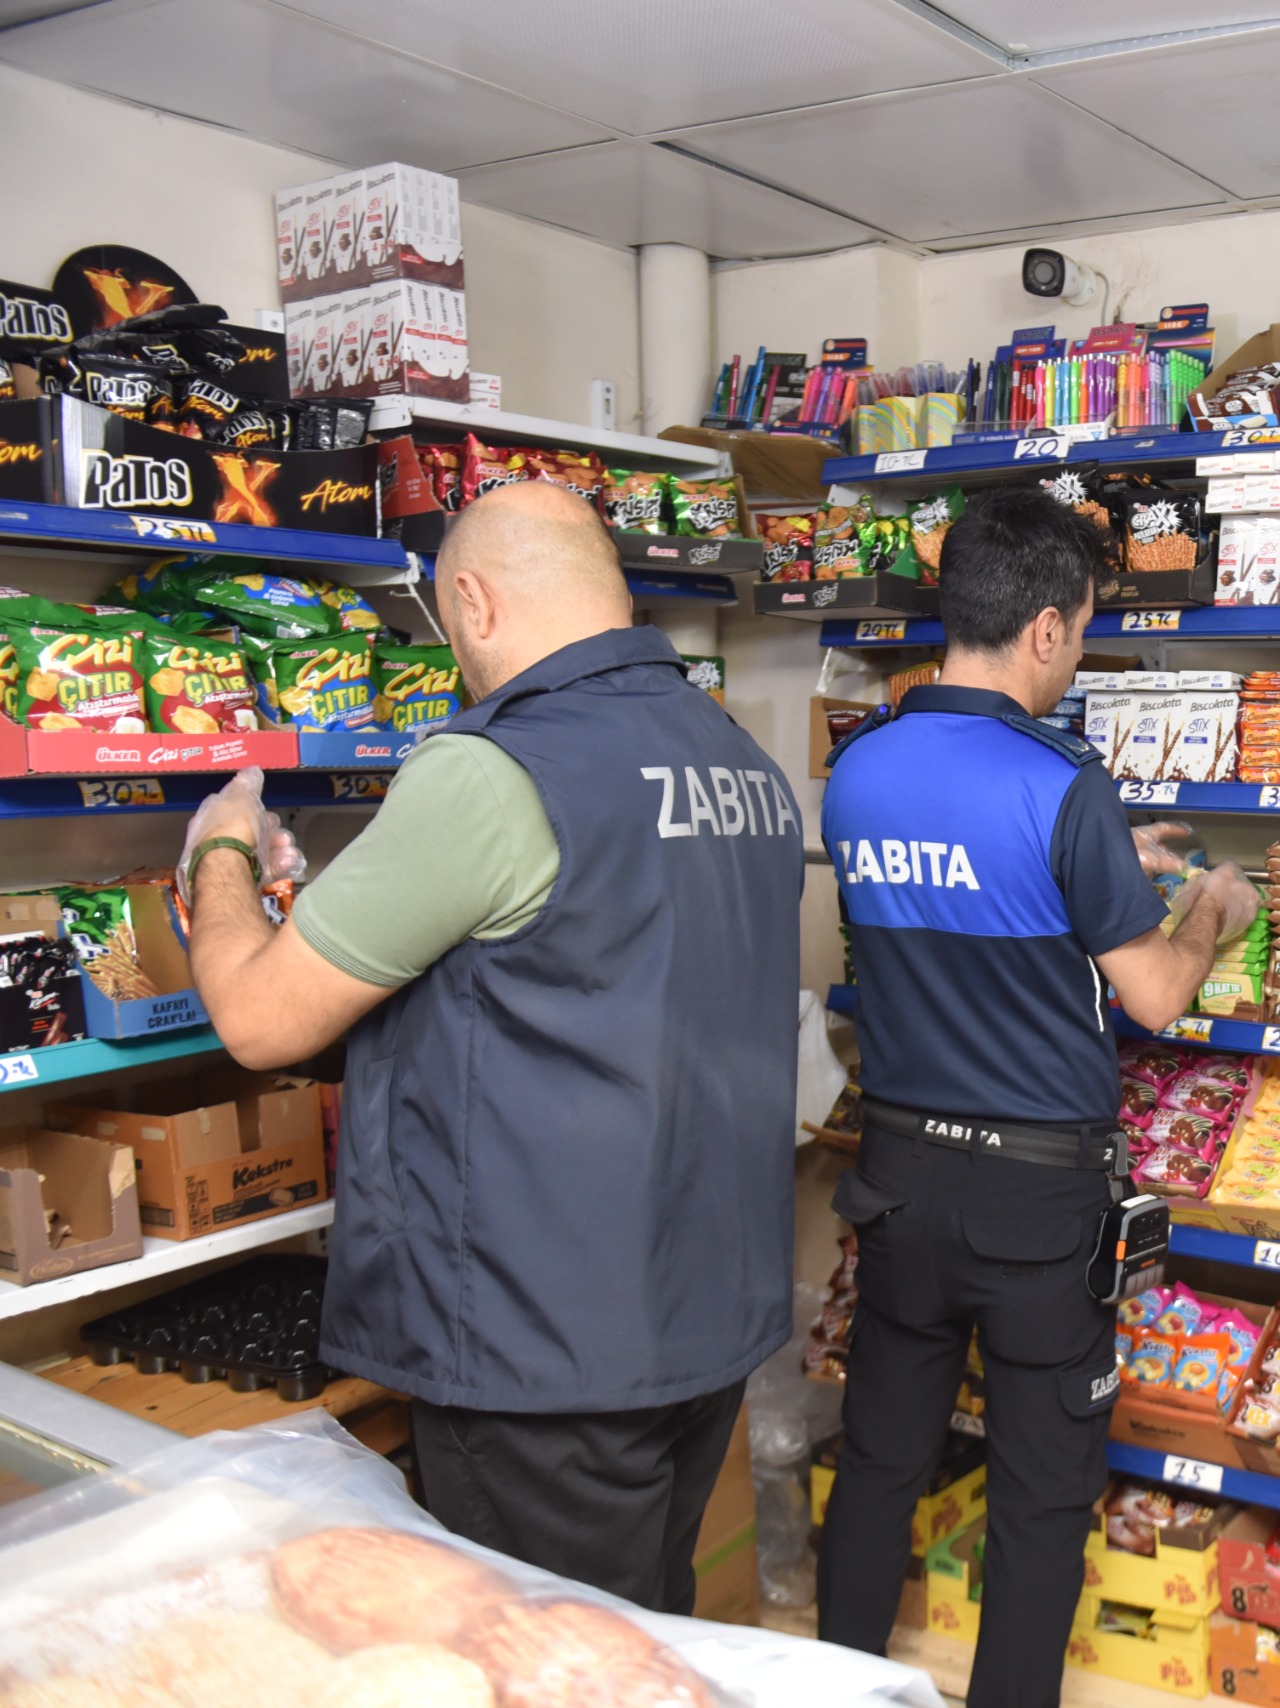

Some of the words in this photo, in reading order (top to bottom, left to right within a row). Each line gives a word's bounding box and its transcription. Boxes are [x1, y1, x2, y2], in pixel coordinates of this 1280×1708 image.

[1022, 439, 1059, 458] 20
[301, 478, 373, 514] Atom
[296, 647, 372, 692] Çizi
[383, 662, 461, 701] Çizi
[57, 671, 134, 713] ÇITIR
[1089, 697, 1131, 713] Biscolata
[1139, 697, 1182, 713] Biscolata
[312, 685, 370, 726] ÇITIR
[393, 699, 450, 733] ÇITIR
[1189, 697, 1234, 714] Biscolata
[96, 746, 141, 763] ÜLKER
[355, 744, 392, 758] ÜLKER
[640, 766, 800, 839] ZABITA
[1123, 781, 1156, 803] 35
[837, 839, 981, 891] ZABITA
[151, 998, 189, 1016] KAFAYI
[232, 1156, 294, 1190] Kekstra
[1174, 1460, 1206, 1484] 15
[1231, 1586, 1247, 1613] 8
[1221, 1669, 1236, 1694] 8
